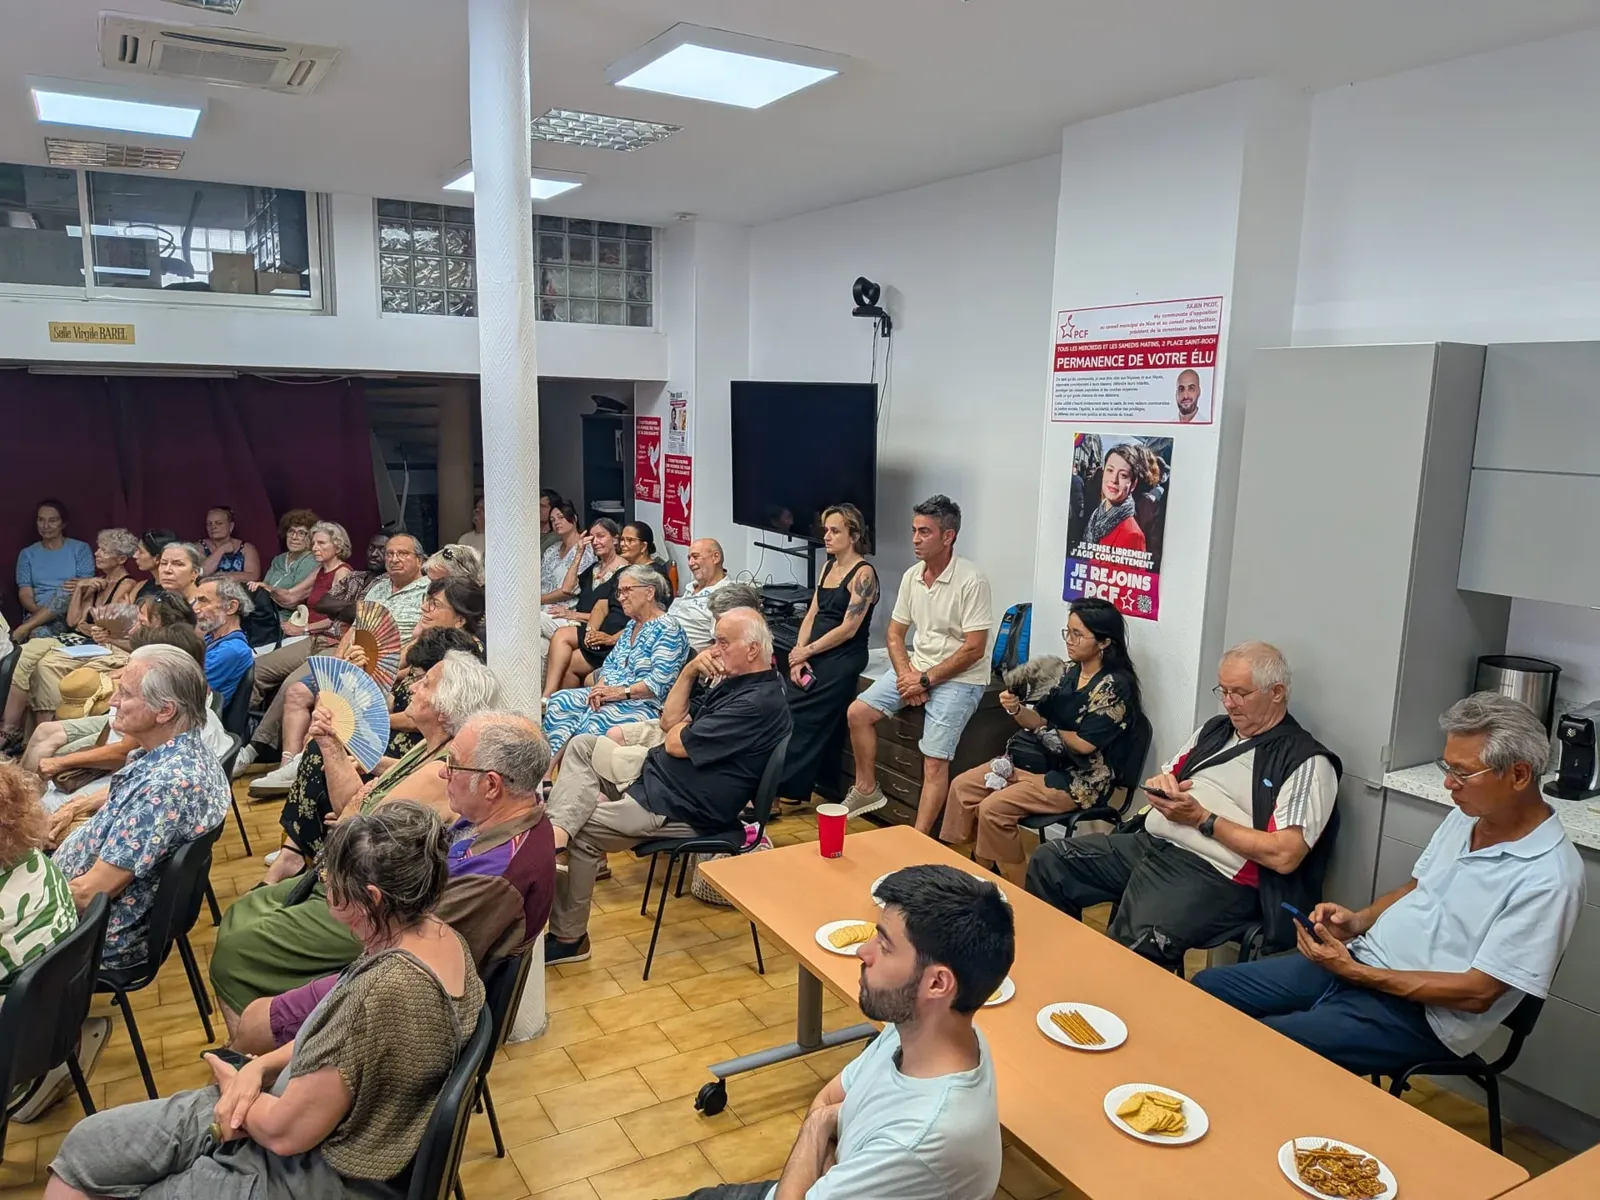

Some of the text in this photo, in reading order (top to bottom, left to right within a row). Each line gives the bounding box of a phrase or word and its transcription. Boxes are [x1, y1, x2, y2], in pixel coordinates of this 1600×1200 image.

[54, 326, 128, 342] Salle Virgile BAREL
[1074, 329, 1088, 338] PCF
[1056, 348, 1214, 369] PERMANENCE DE VOTRE ÉLU
[1070, 548, 1093, 559] J'AGIS
[1088, 543, 1110, 553] PENSE
[1112, 547, 1152, 560] LIBREMENT
[1071, 563, 1151, 591] JE REJOINS
[1070, 578, 1120, 604] LE PCF
